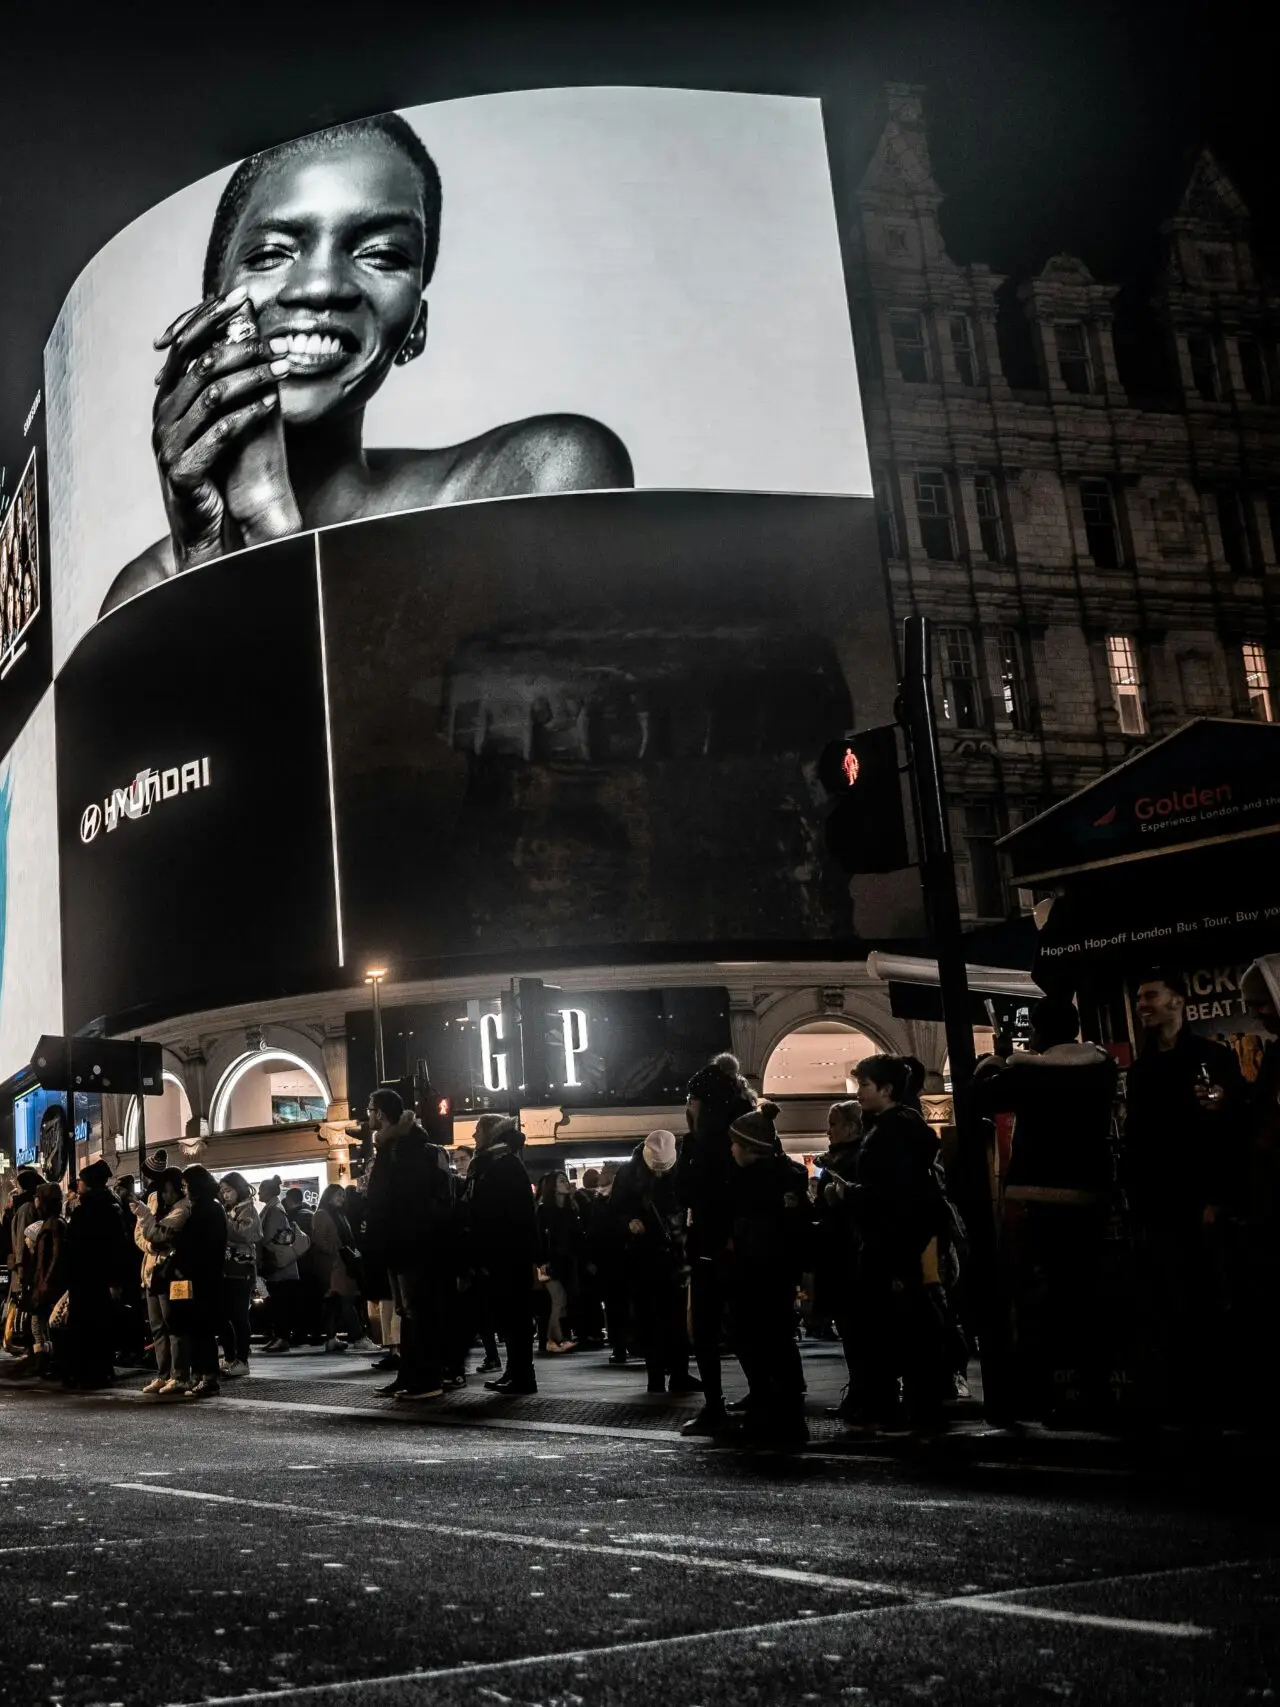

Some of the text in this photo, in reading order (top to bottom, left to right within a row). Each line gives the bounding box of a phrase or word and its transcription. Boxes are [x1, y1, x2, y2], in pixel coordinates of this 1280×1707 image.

[104, 757, 210, 826] HYUNDAI
[1134, 784, 1232, 820] Golden
[1140, 814, 1197, 833] Experience
[1200, 805, 1239, 820] London
[1242, 797, 1262, 812] and
[1040, 942, 1081, 957] Hop-on
[1084, 933, 1128, 951] Hop-off
[1131, 926, 1172, 942] London
[1176, 921, 1198, 933] Bus
[1235, 909, 1259, 923] Buy
[1185, 999, 1234, 1021] BEAT
[480, 1008, 589, 1092] GP
